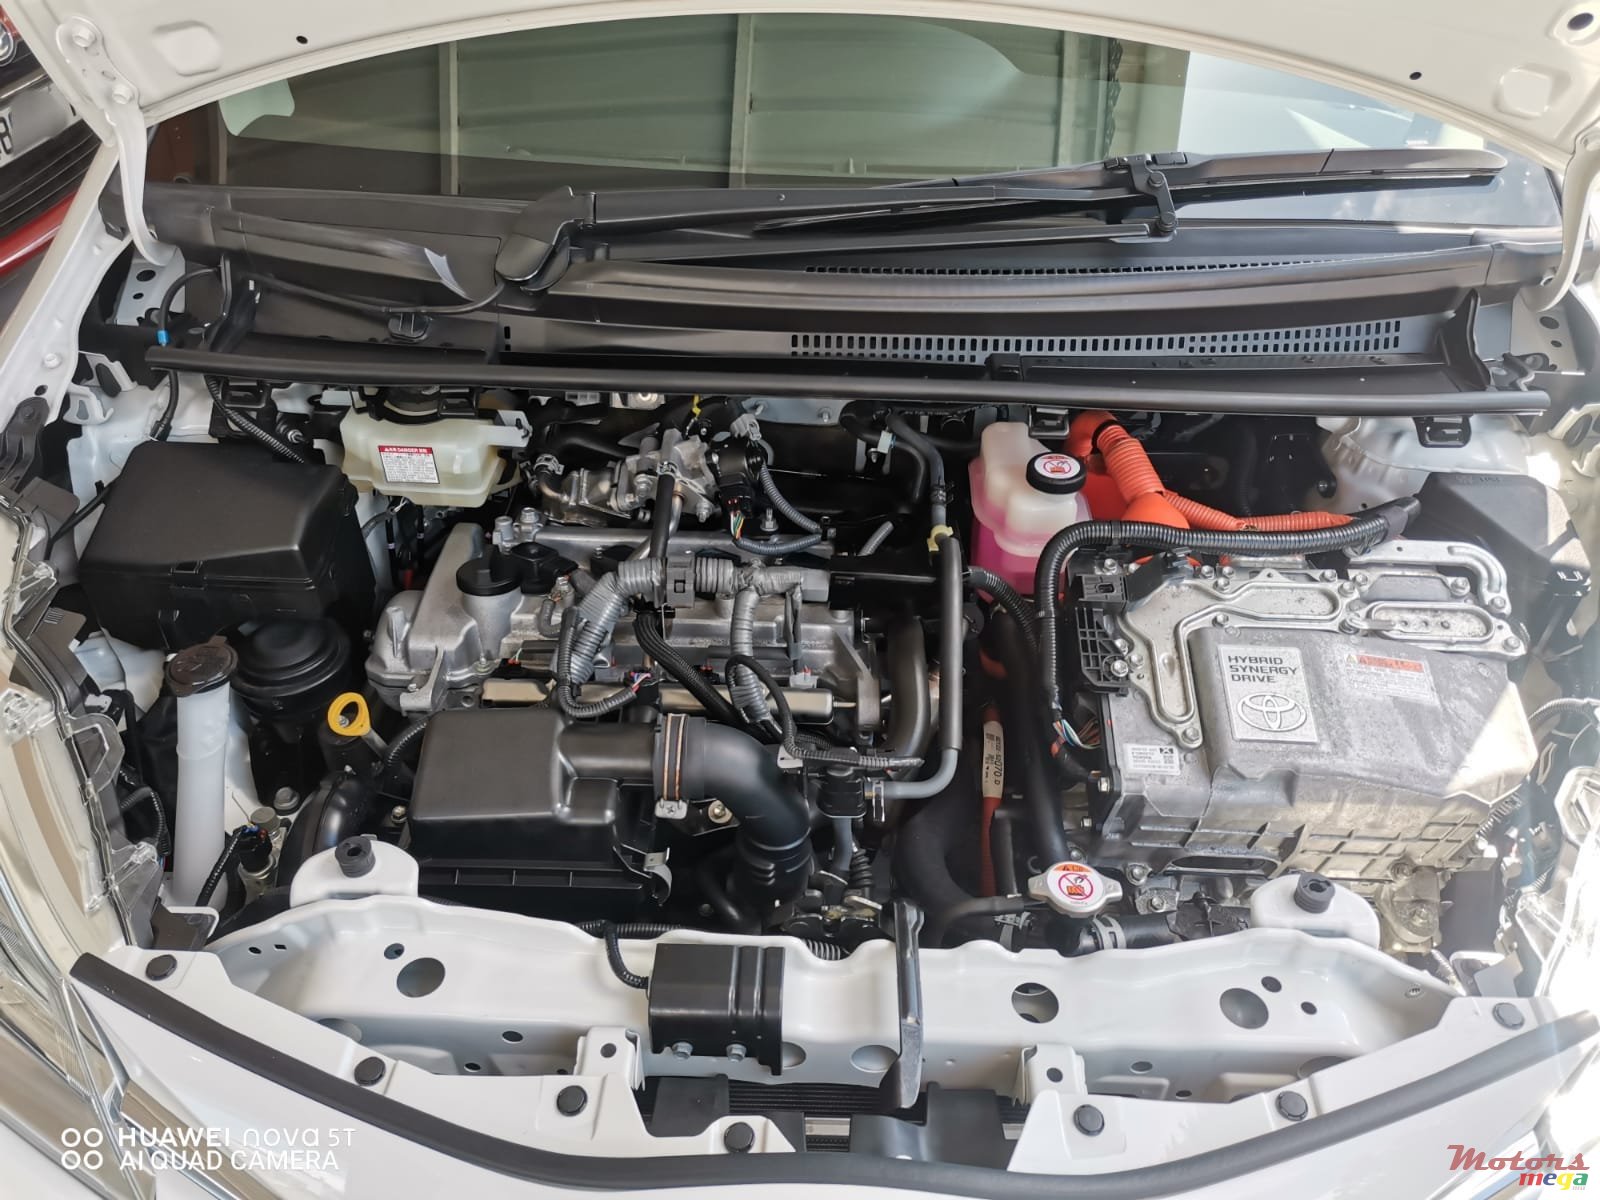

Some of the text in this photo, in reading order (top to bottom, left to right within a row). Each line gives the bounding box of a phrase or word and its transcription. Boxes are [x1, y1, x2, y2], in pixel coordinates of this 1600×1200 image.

[1227, 655, 1284, 665] HYBRID
[1229, 664, 1298, 675] SYNERGY
[1231, 674, 1277, 683] DRIVE
